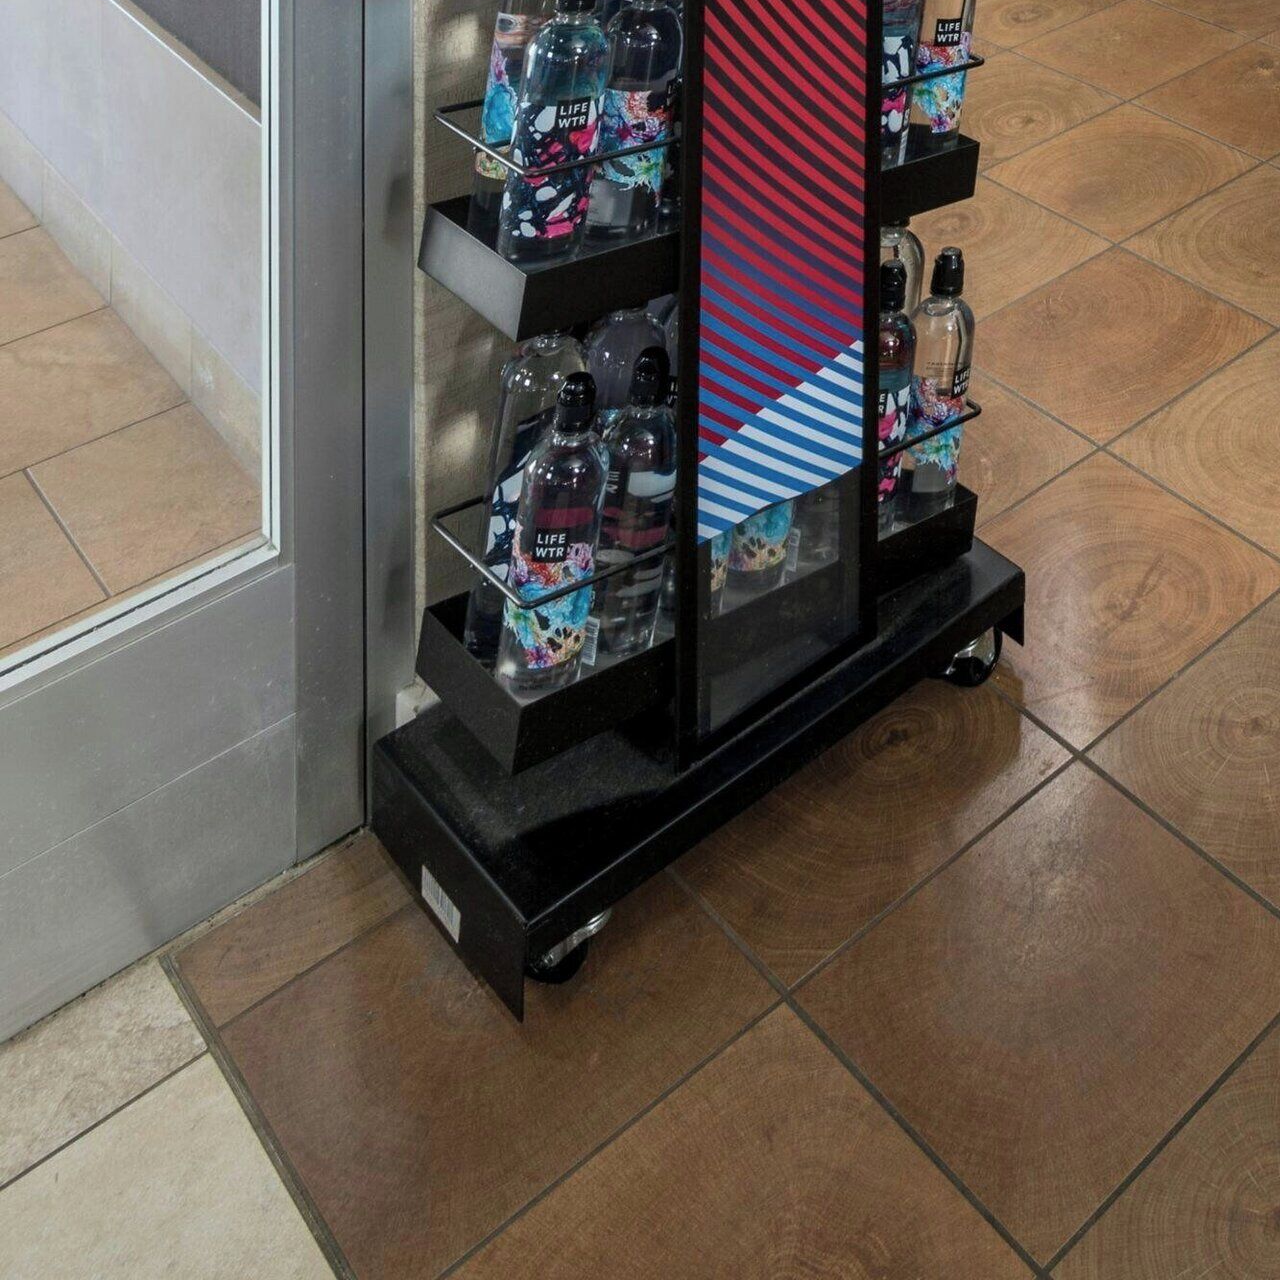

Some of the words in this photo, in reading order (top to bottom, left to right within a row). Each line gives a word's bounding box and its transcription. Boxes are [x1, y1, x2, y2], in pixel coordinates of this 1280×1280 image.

[938, 22, 960, 32] LIFE
[937, 32, 960, 43] WTR
[559, 101, 588, 116] LIFE
[557, 115, 587, 128] WTR
[536, 533, 566, 545] LIFE
[535, 546, 565, 558] WTR
